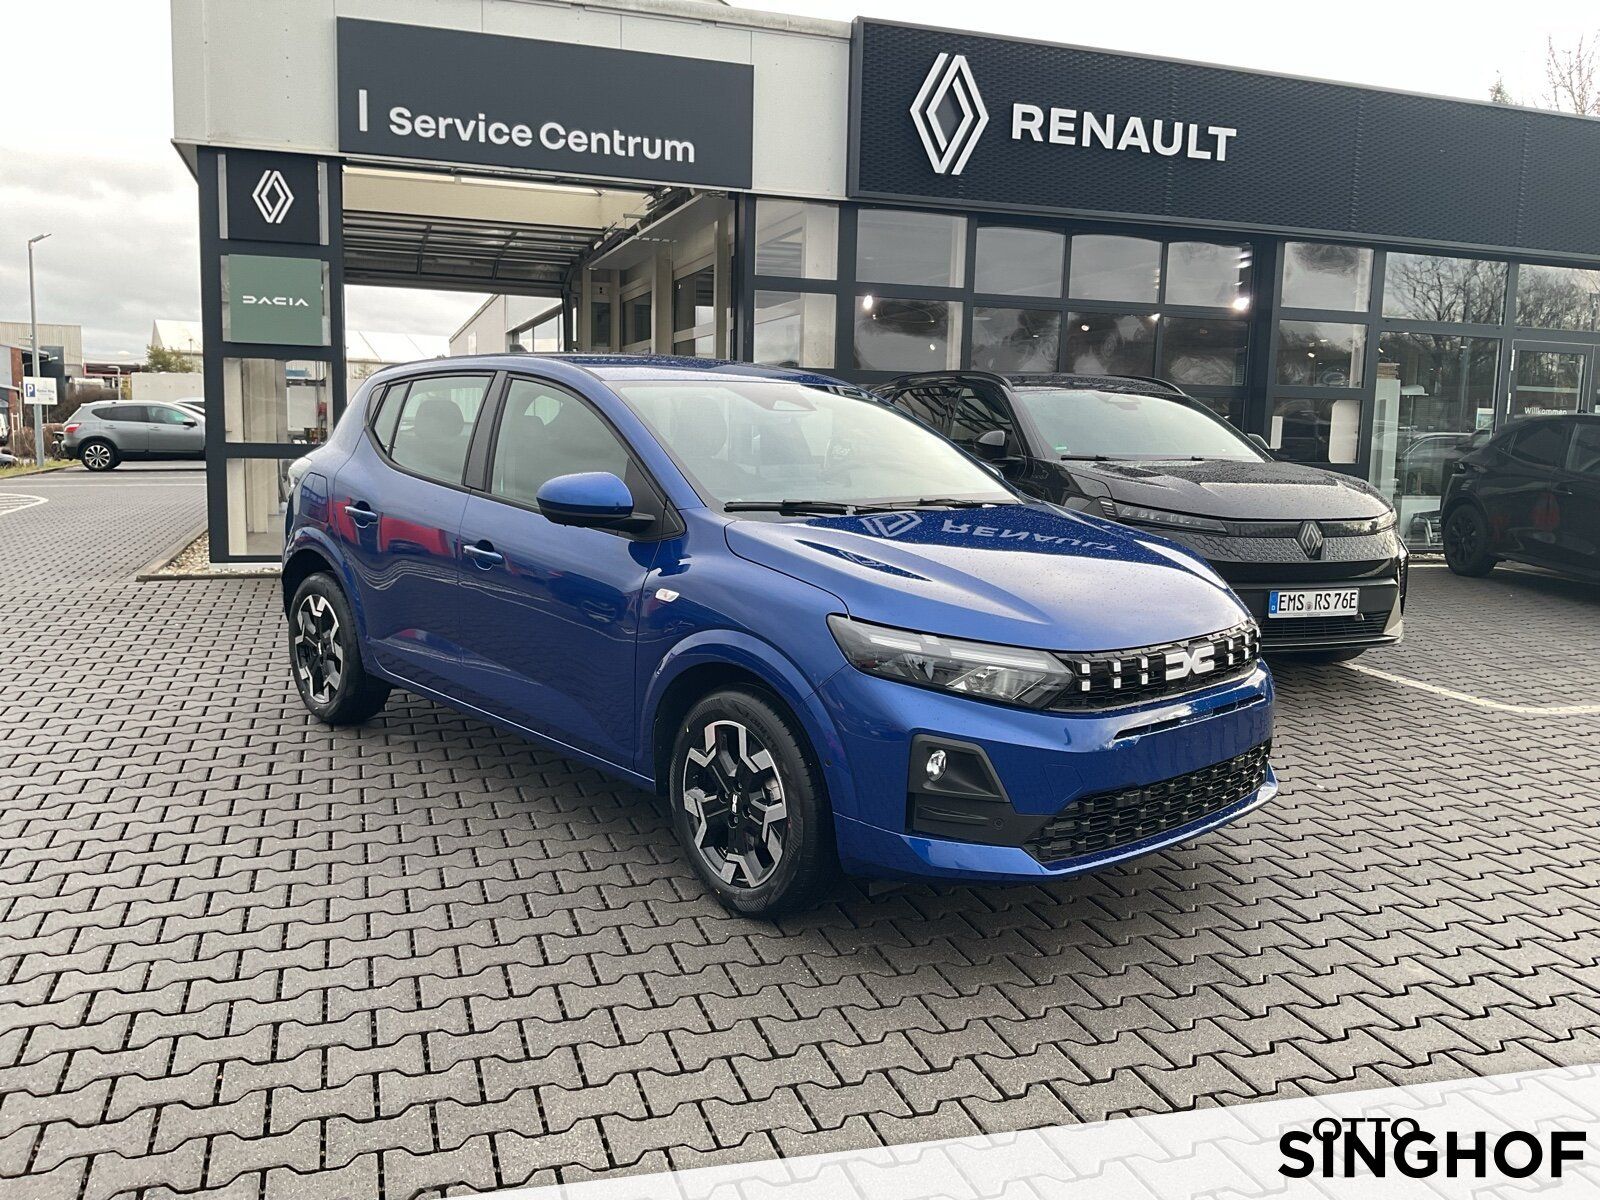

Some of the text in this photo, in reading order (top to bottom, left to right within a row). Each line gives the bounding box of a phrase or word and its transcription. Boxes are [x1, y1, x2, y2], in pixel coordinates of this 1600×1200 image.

[389, 106, 695, 163] Service Centrum
[1011, 103, 1237, 162] RENAULT
[242, 295, 309, 307] DACIA
[1524, 406, 1568, 415] Willkommen
[1278, 592, 1357, 611] EMS RS 76E
